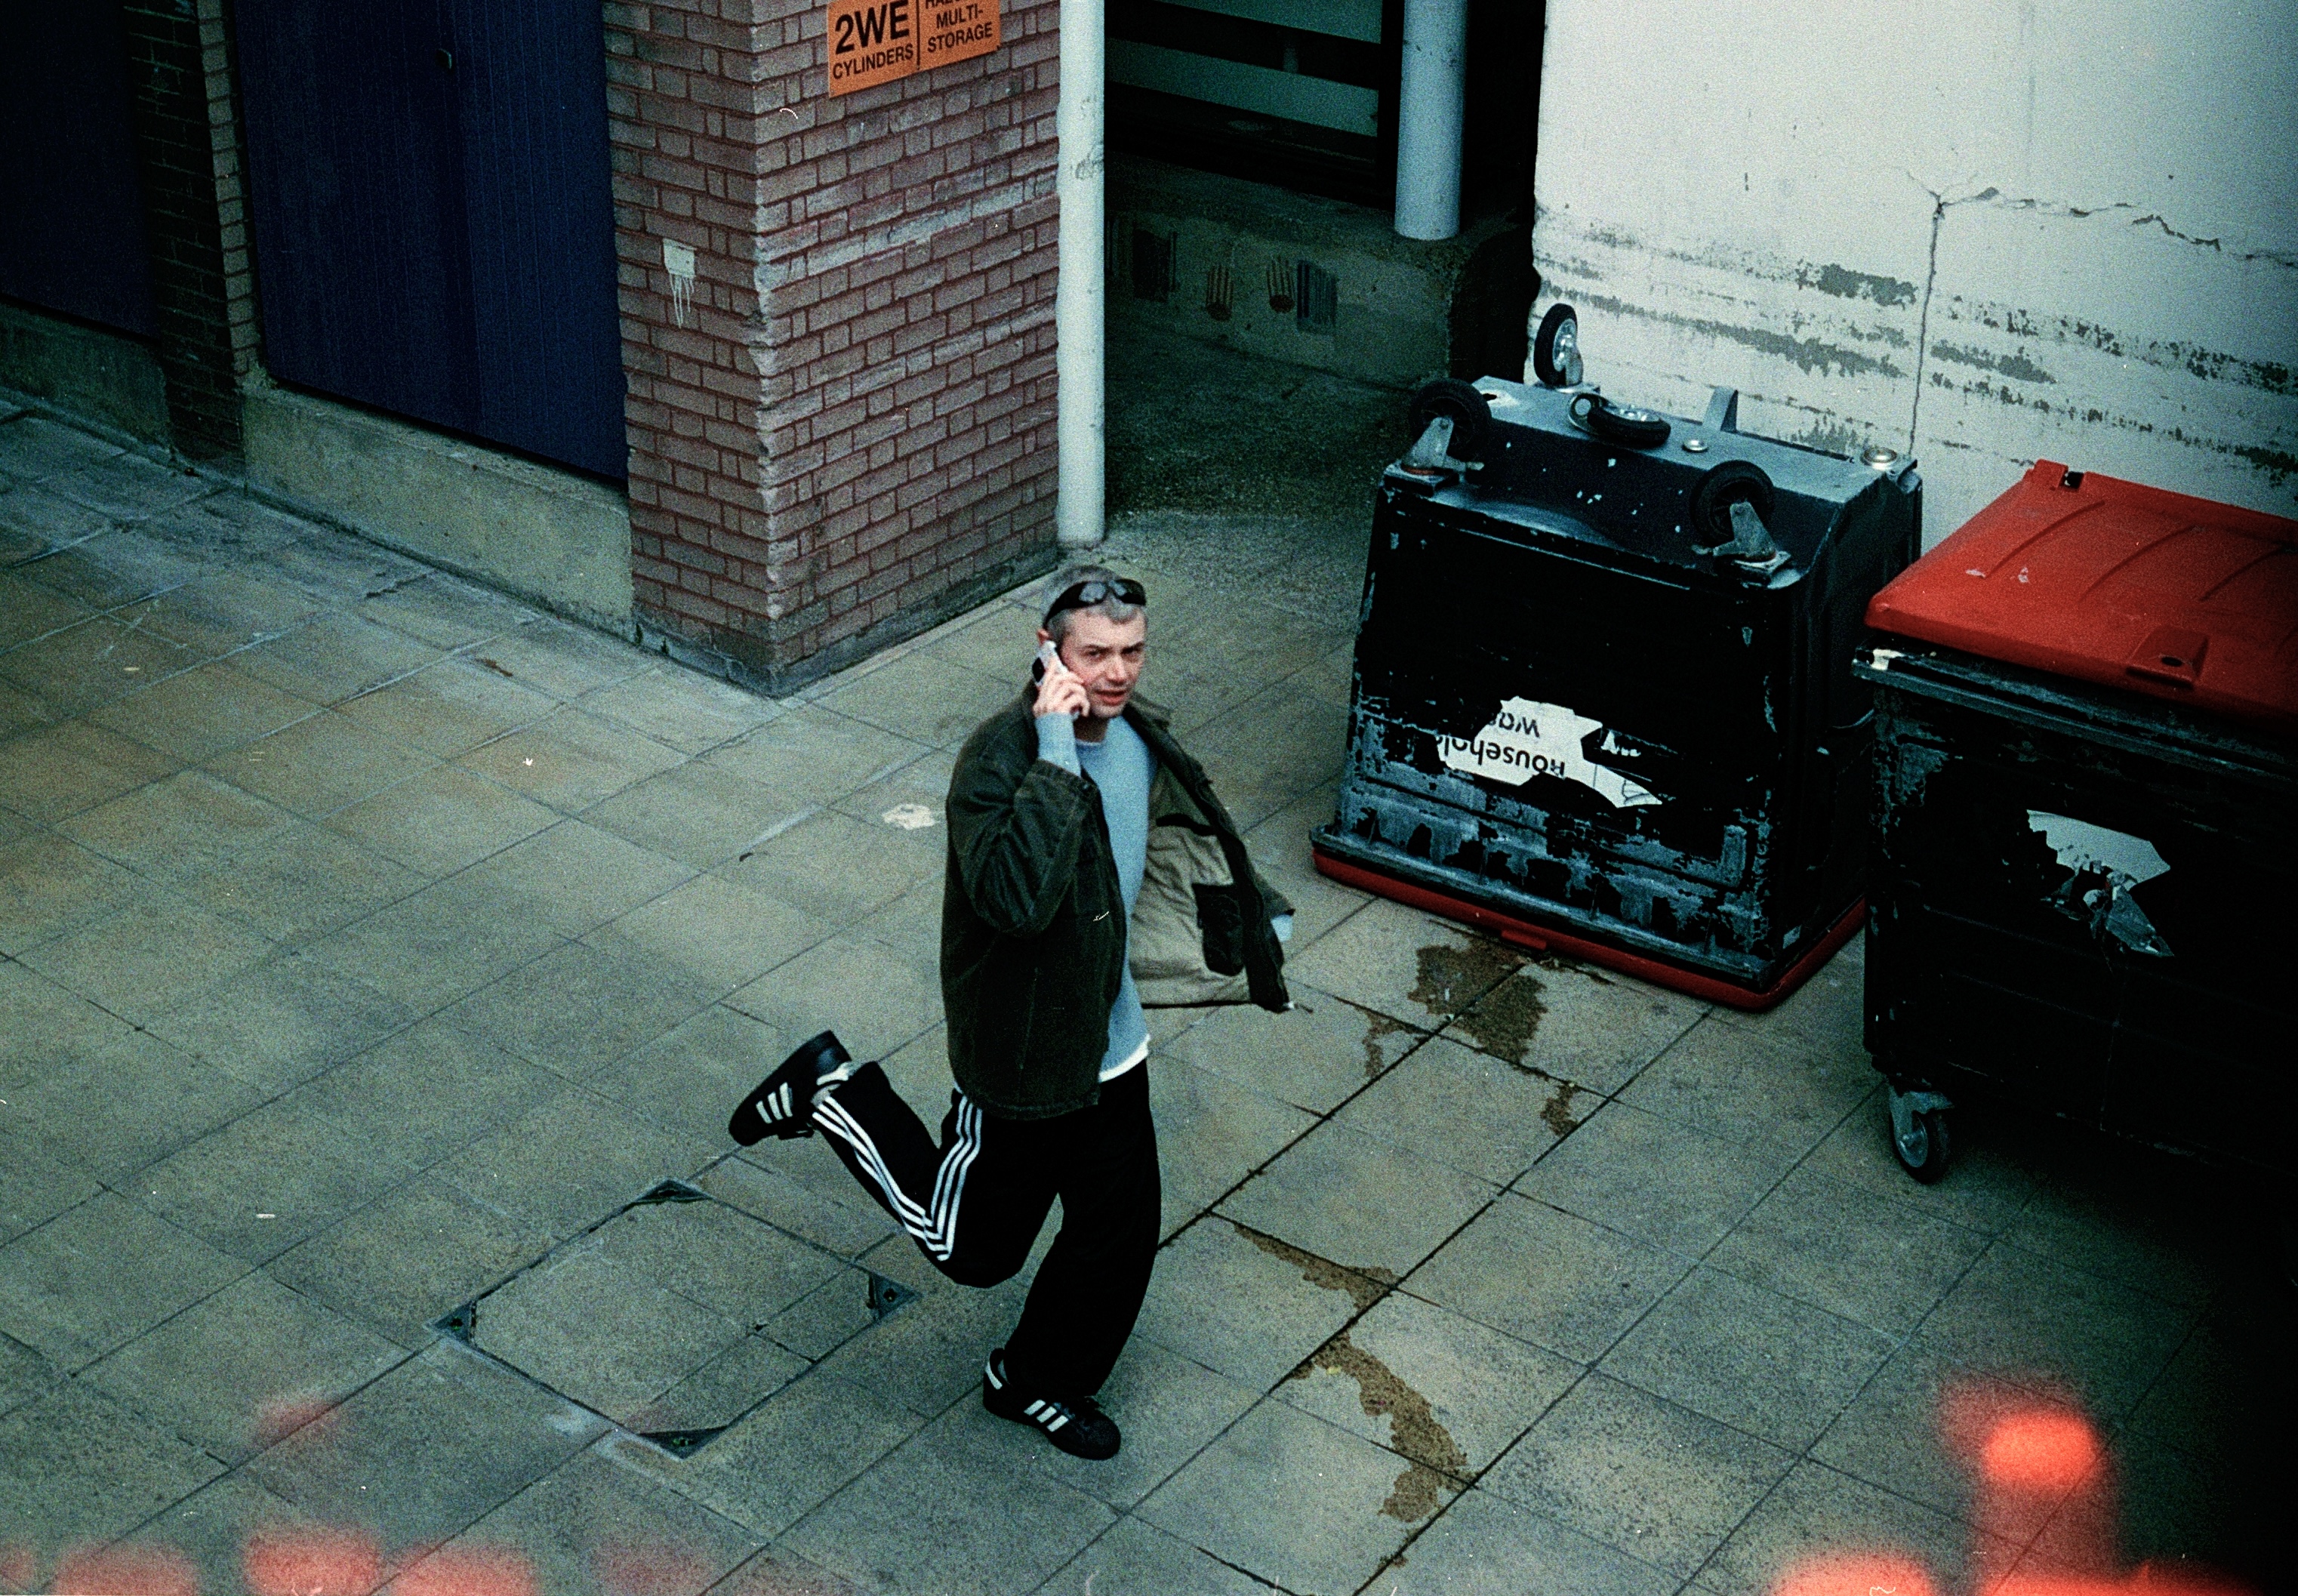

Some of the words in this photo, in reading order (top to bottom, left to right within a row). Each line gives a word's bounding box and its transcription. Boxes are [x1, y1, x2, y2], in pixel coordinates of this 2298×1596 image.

[835, 1, 910, 54] 2WE
[936, 3, 984, 29] MULTI-
[927, 23, 993, 52] STORAGE
[833, 44, 913, 79] CYLINDERS
